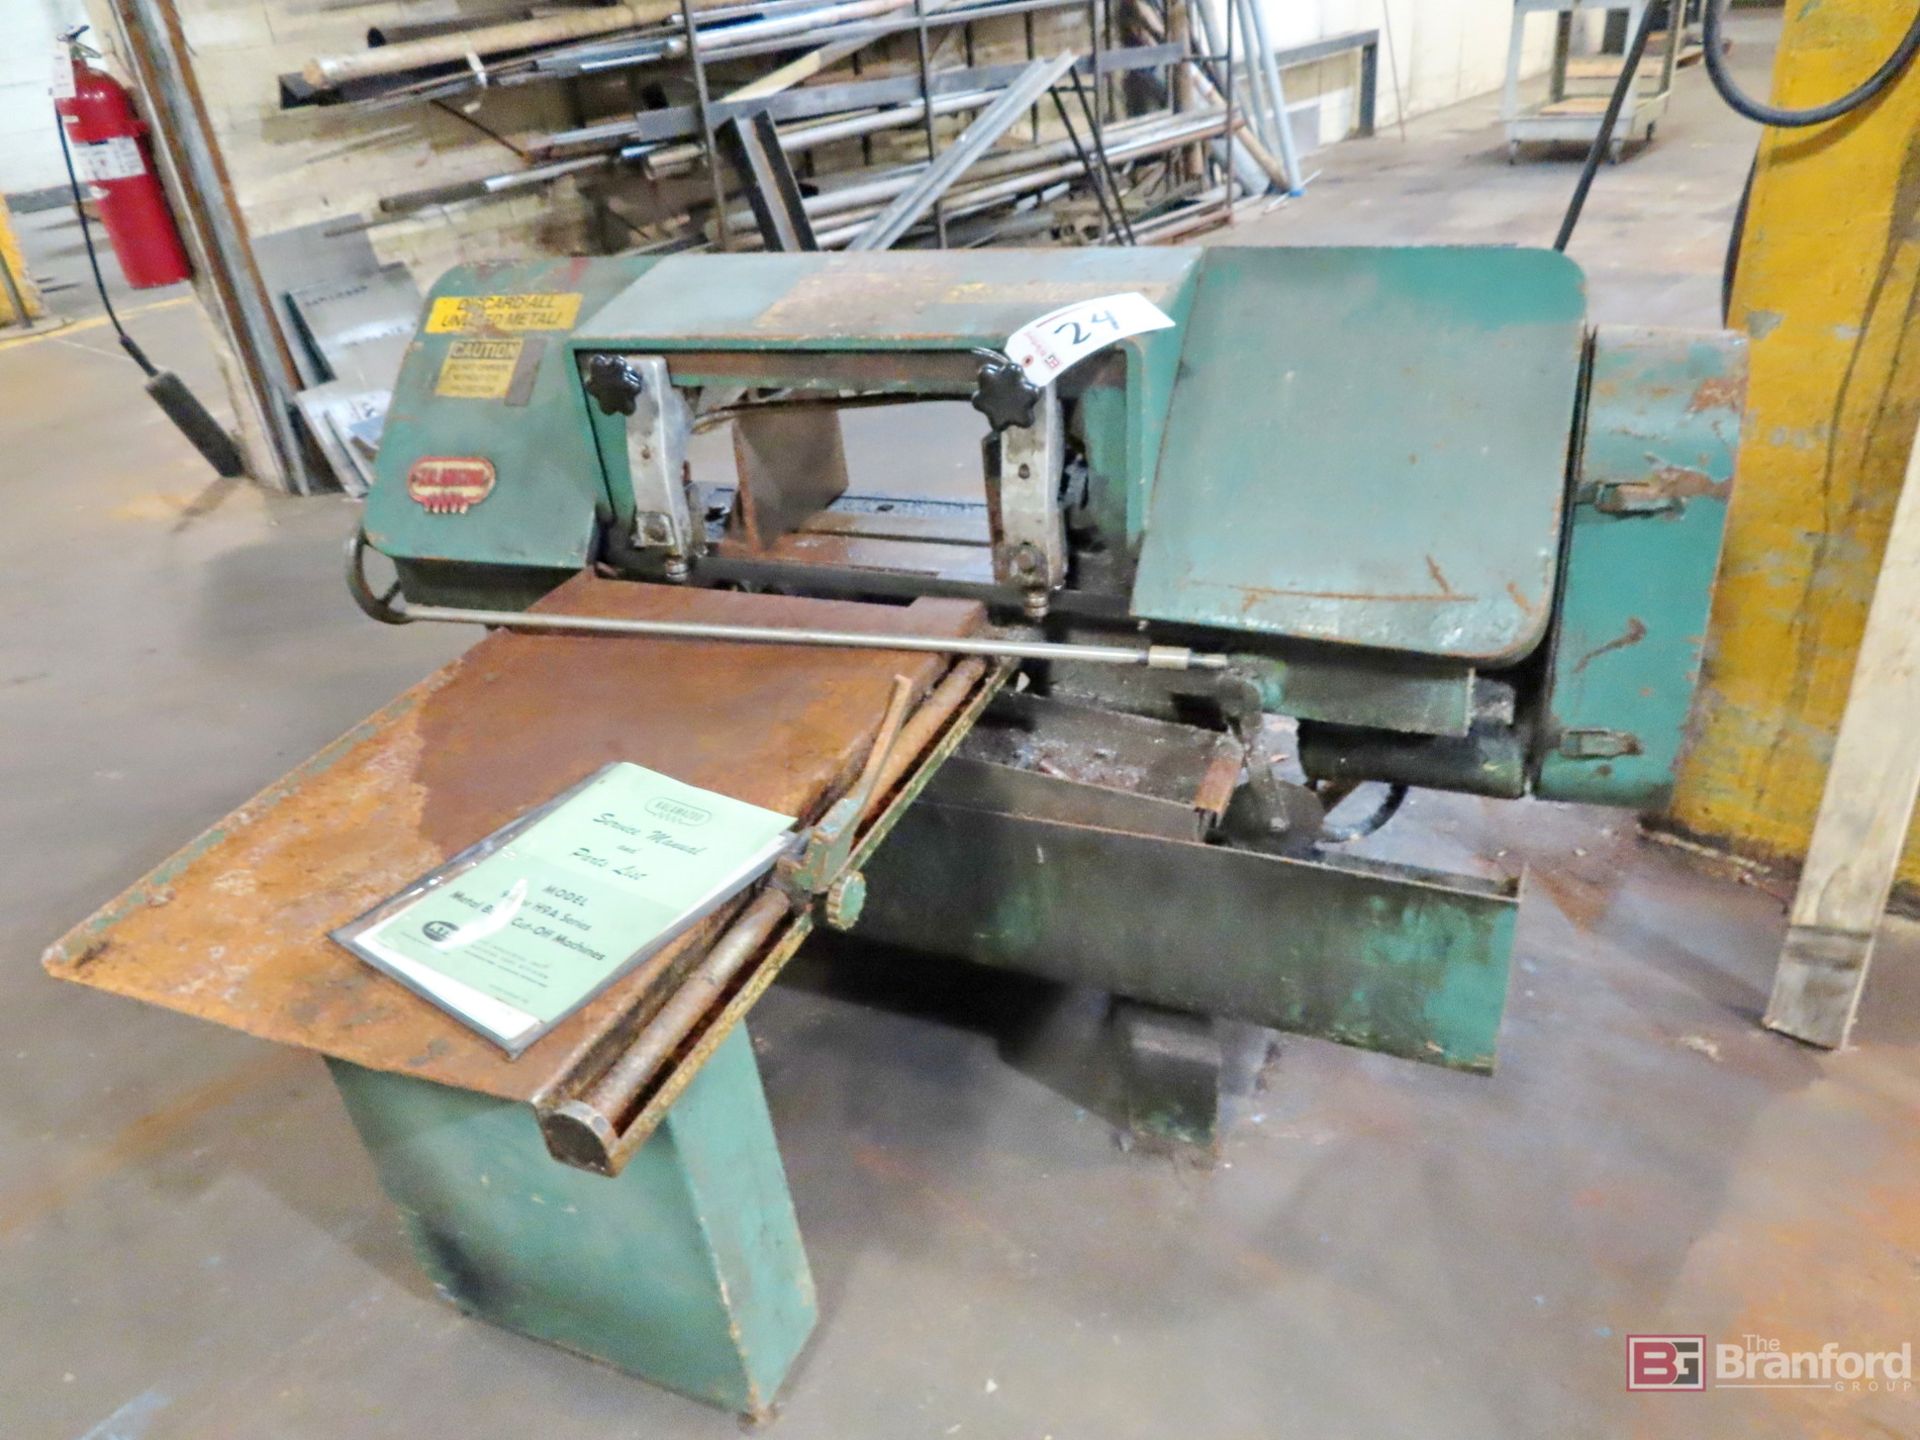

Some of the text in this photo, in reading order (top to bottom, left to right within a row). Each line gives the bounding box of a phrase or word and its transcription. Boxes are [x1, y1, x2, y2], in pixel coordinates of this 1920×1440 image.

[529, 294, 555, 308] ALL
[1054, 310, 1120, 345] 24
[451, 342, 519, 358] CAUTION
[646, 830, 708, 855] Manual
[569, 847, 648, 880] Parts List
[542, 884, 589, 907] MODEL
[450, 890, 484, 909] Metal
[511, 917, 555, 938] Cut-Off
[552, 933, 606, 961] Machines
[559, 912, 593, 932] Series
